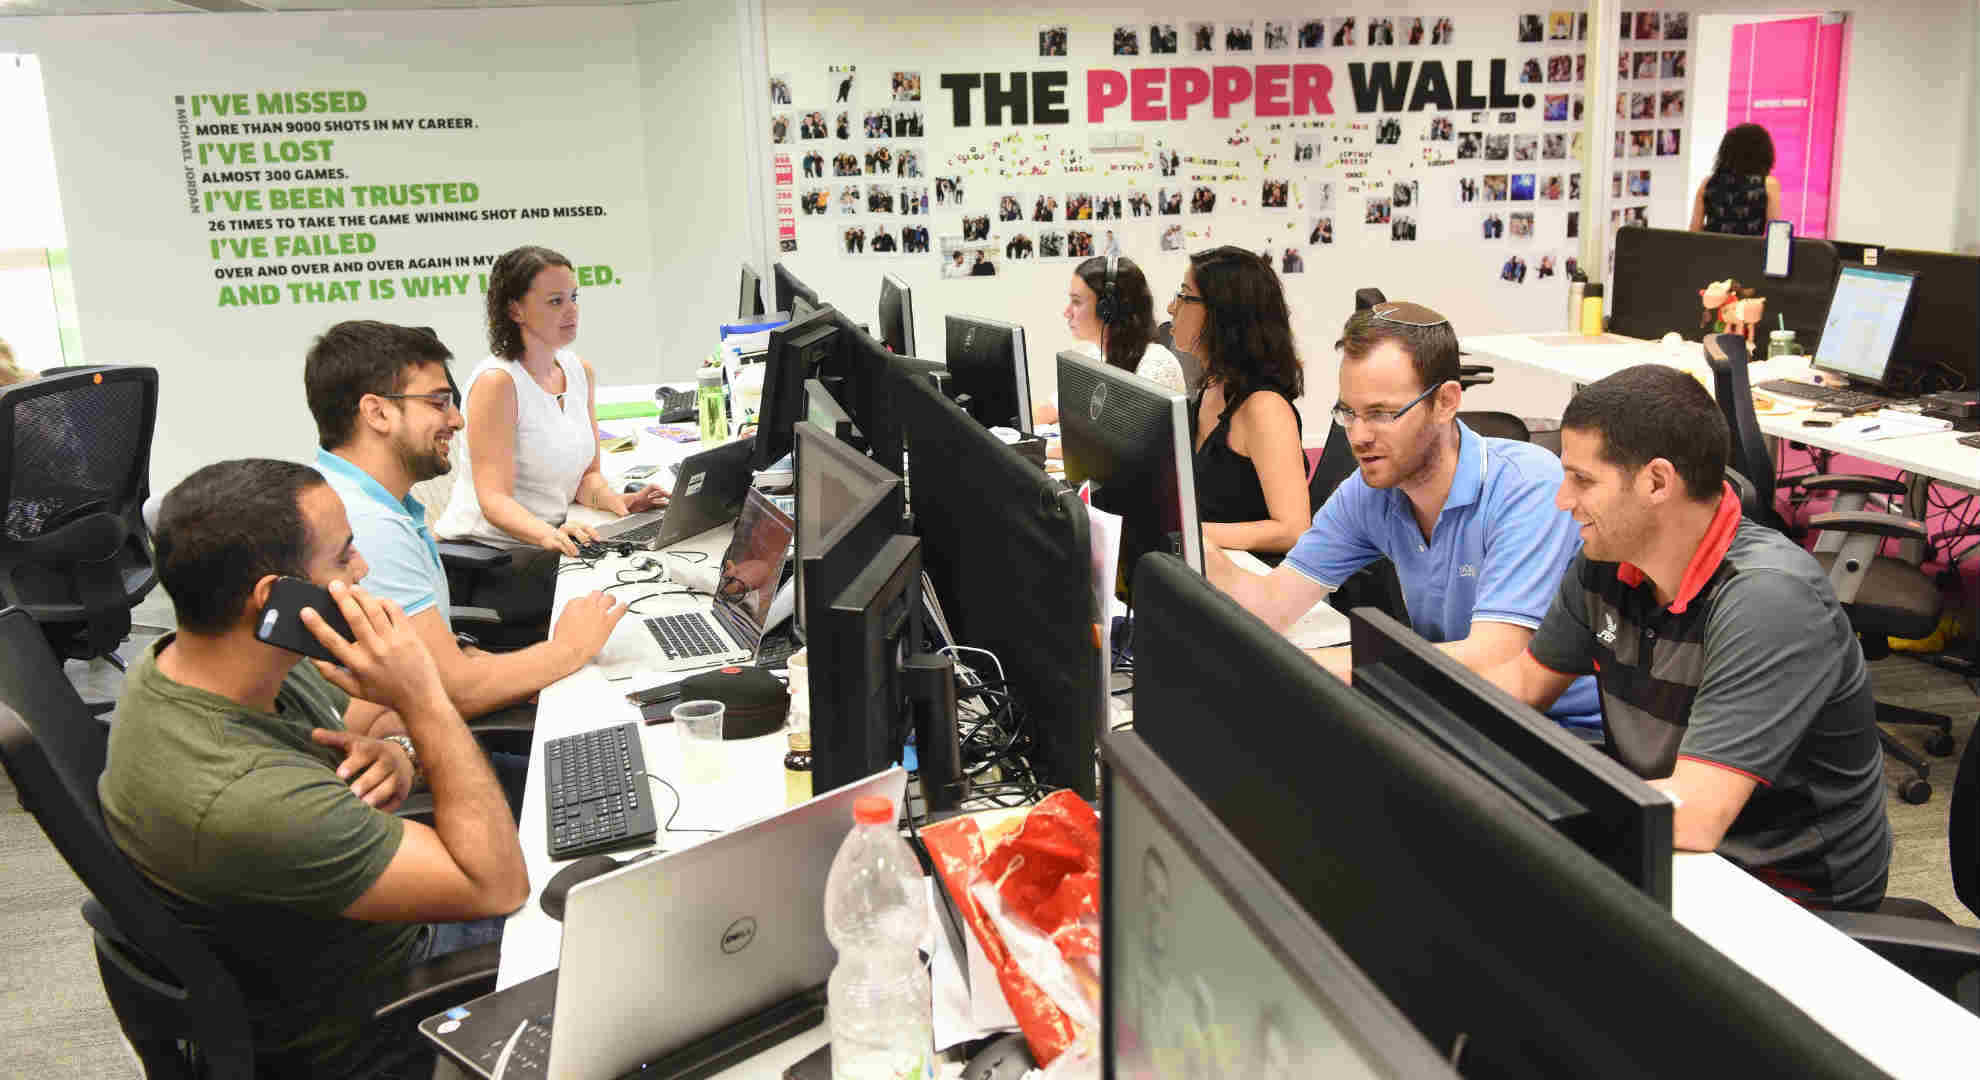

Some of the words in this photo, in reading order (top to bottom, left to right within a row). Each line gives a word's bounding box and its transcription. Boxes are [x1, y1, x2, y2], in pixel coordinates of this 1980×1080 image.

[191, 94, 250, 116] I'VE
[257, 90, 367, 114] MISSED
[941, 71, 1069, 127] THE
[1087, 64, 1335, 123] PEPPER
[1348, 59, 1536, 112] WALL.
[177, 108, 192, 162] MICHAEL
[196, 123, 239, 136] MORE
[242, 121, 283, 134] THAN
[286, 121, 322, 133] 9000
[324, 120, 370, 132] SHOTS
[373, 119, 389, 130] IN
[391, 118, 416, 130] MY
[418, 117, 479, 129] CAREER.
[198, 142, 257, 165] I'VE
[263, 140, 334, 163] LOST
[184, 166, 200, 213] JORDAN
[202, 171, 261, 184] ALMOST
[264, 170, 291, 182] 300
[295, 168, 349, 181] GAMES.
[205, 189, 263, 212] I'VE
[270, 187, 344, 210] BEEN
[351, 182, 480, 207] TRUSTED
[208, 221, 225, 232] 26
[229, 218, 274, 231] TIMES
[277, 218, 296, 229] TO
[299, 216, 336, 228] TAKE
[339, 215, 366, 226] THE
[369, 213, 411, 225] GAME
[415, 210, 479, 224] WINNING
[482, 209, 518, 221] SHOT
[520, 207, 550, 219] AND
[553, 205, 607, 218] MISSED.
[210, 237, 268, 260] I'VE
[275, 232, 377, 258] FAILED
[215, 266, 254, 279] OVER
[257, 265, 288, 277] AND
[291, 263, 330, 275] OVER
[334, 261, 364, 274] AND
[367, 260, 405, 272] OVER
[409, 258, 452, 270] AGAIN
[455, 257, 470, 268] IN
[473, 256, 495, 266] MY
[218, 284, 280, 307] AND
[287, 281, 362, 304] THAT
[370, 279, 395, 300] IS
[402, 275, 471, 297] WHY
